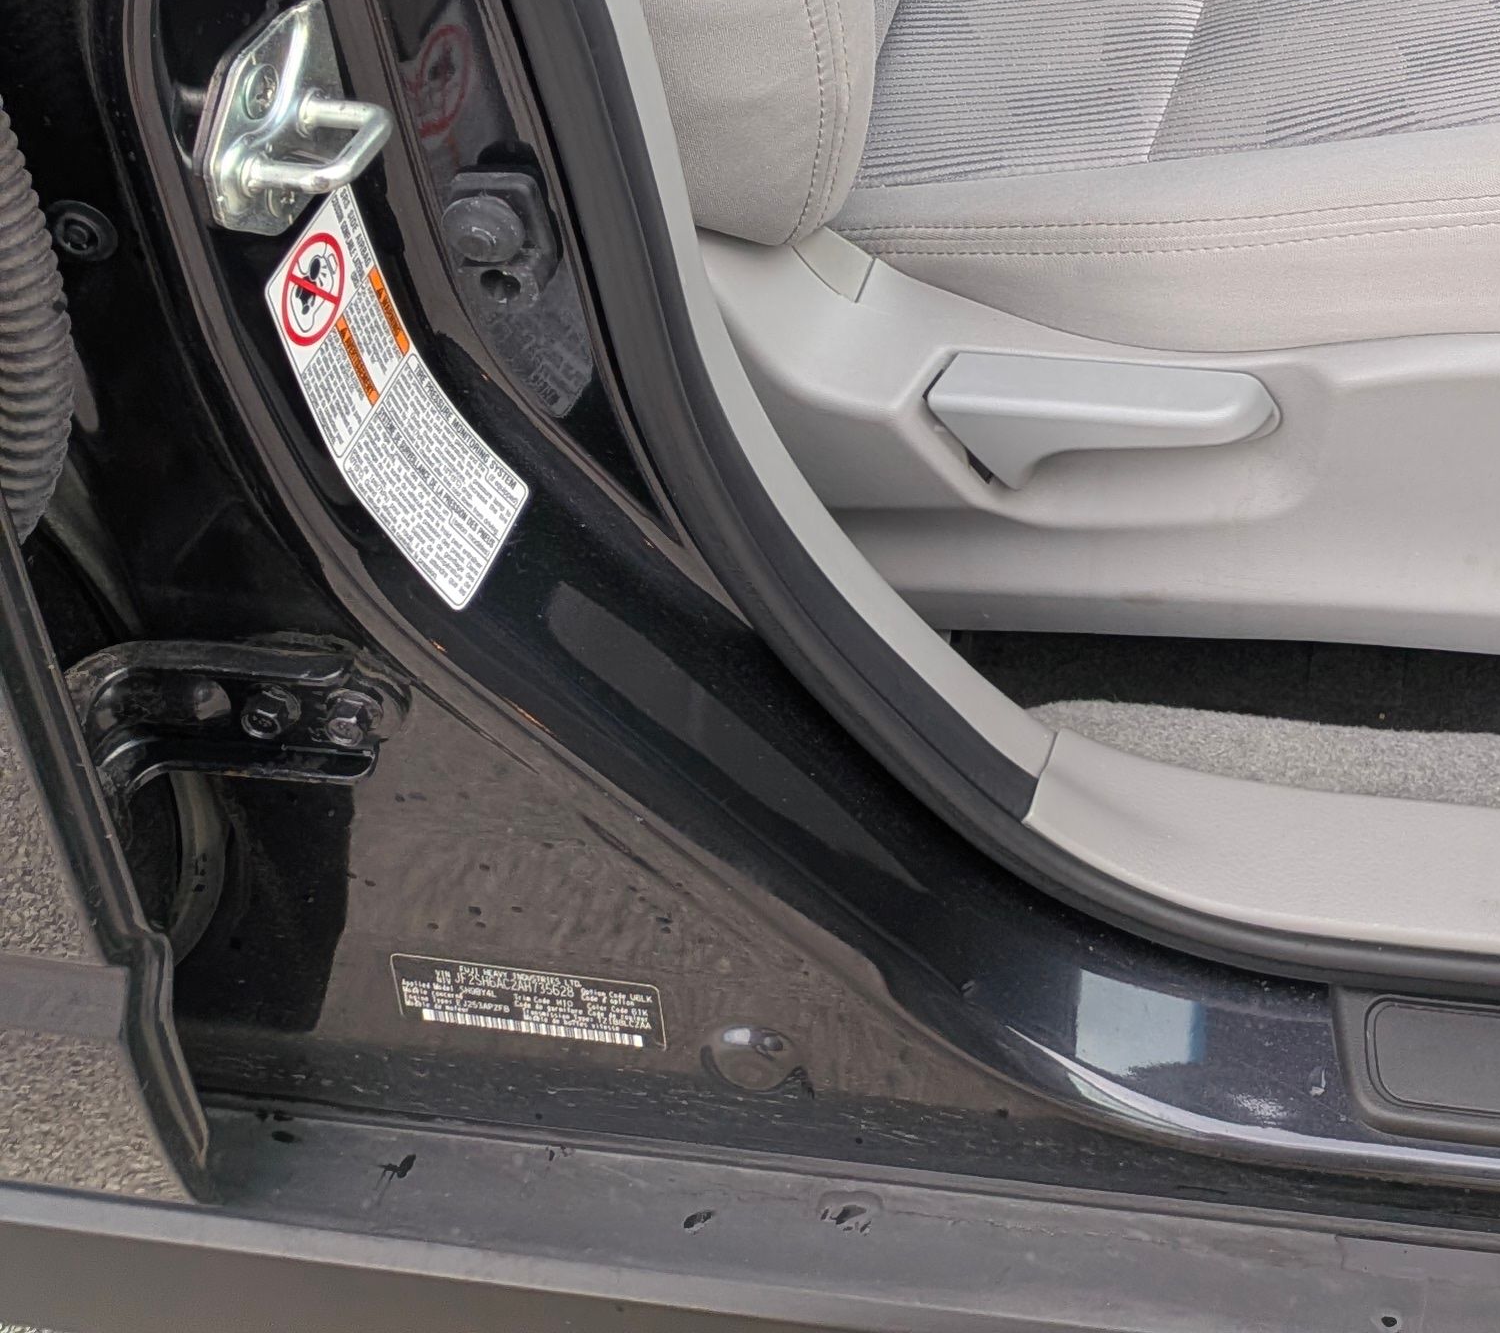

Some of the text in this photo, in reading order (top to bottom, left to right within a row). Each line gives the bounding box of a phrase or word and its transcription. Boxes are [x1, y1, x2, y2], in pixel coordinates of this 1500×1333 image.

[412, 362, 518, 491] TIRE PRESSURE MONITORING SYSTEM
